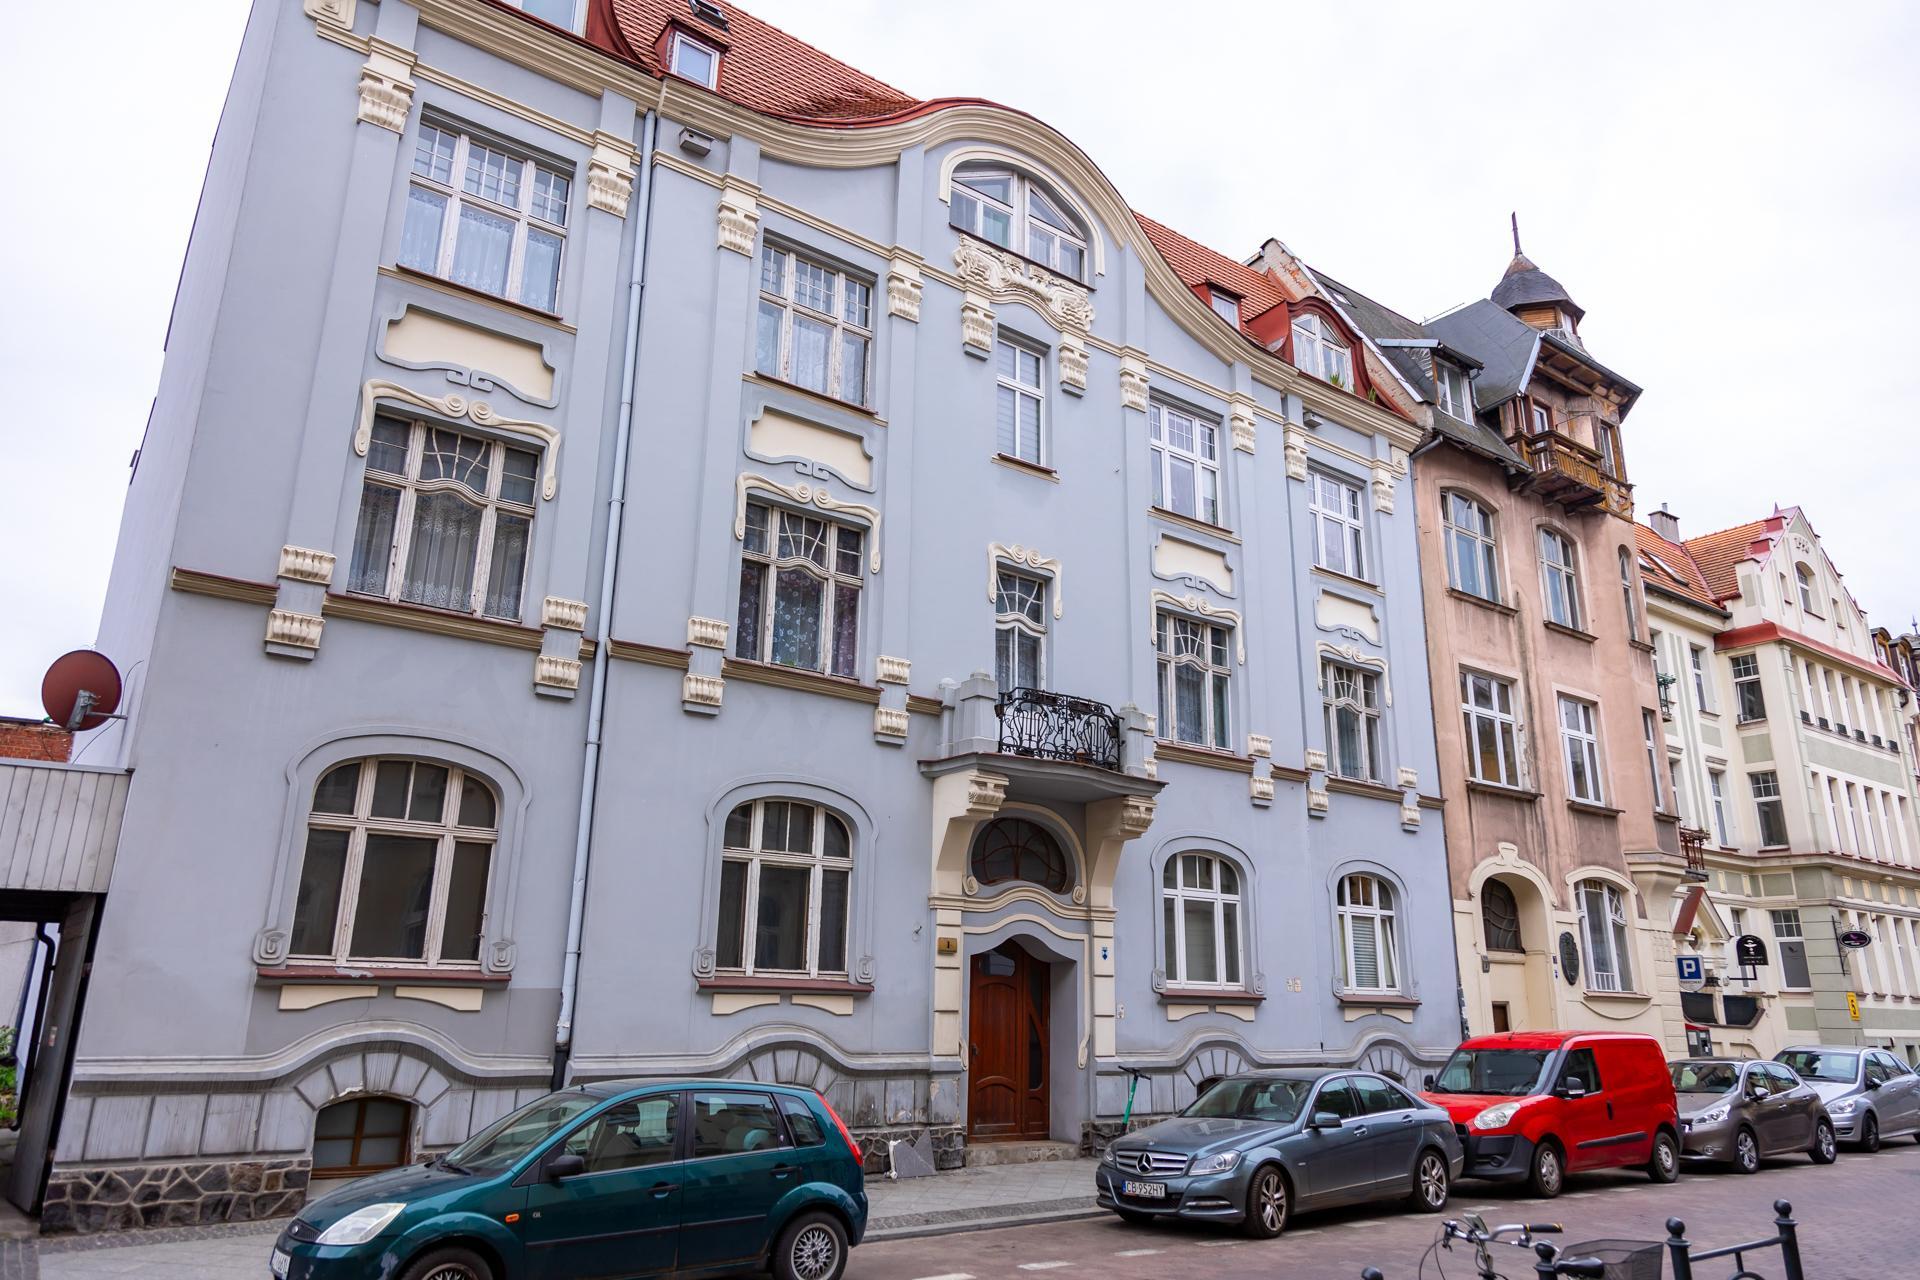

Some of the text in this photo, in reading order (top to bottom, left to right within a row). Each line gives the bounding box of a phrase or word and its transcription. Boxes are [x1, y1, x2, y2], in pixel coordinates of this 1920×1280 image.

[1682, 960, 1696, 977] P
[1126, 1182, 1164, 1196] CB 952HY
